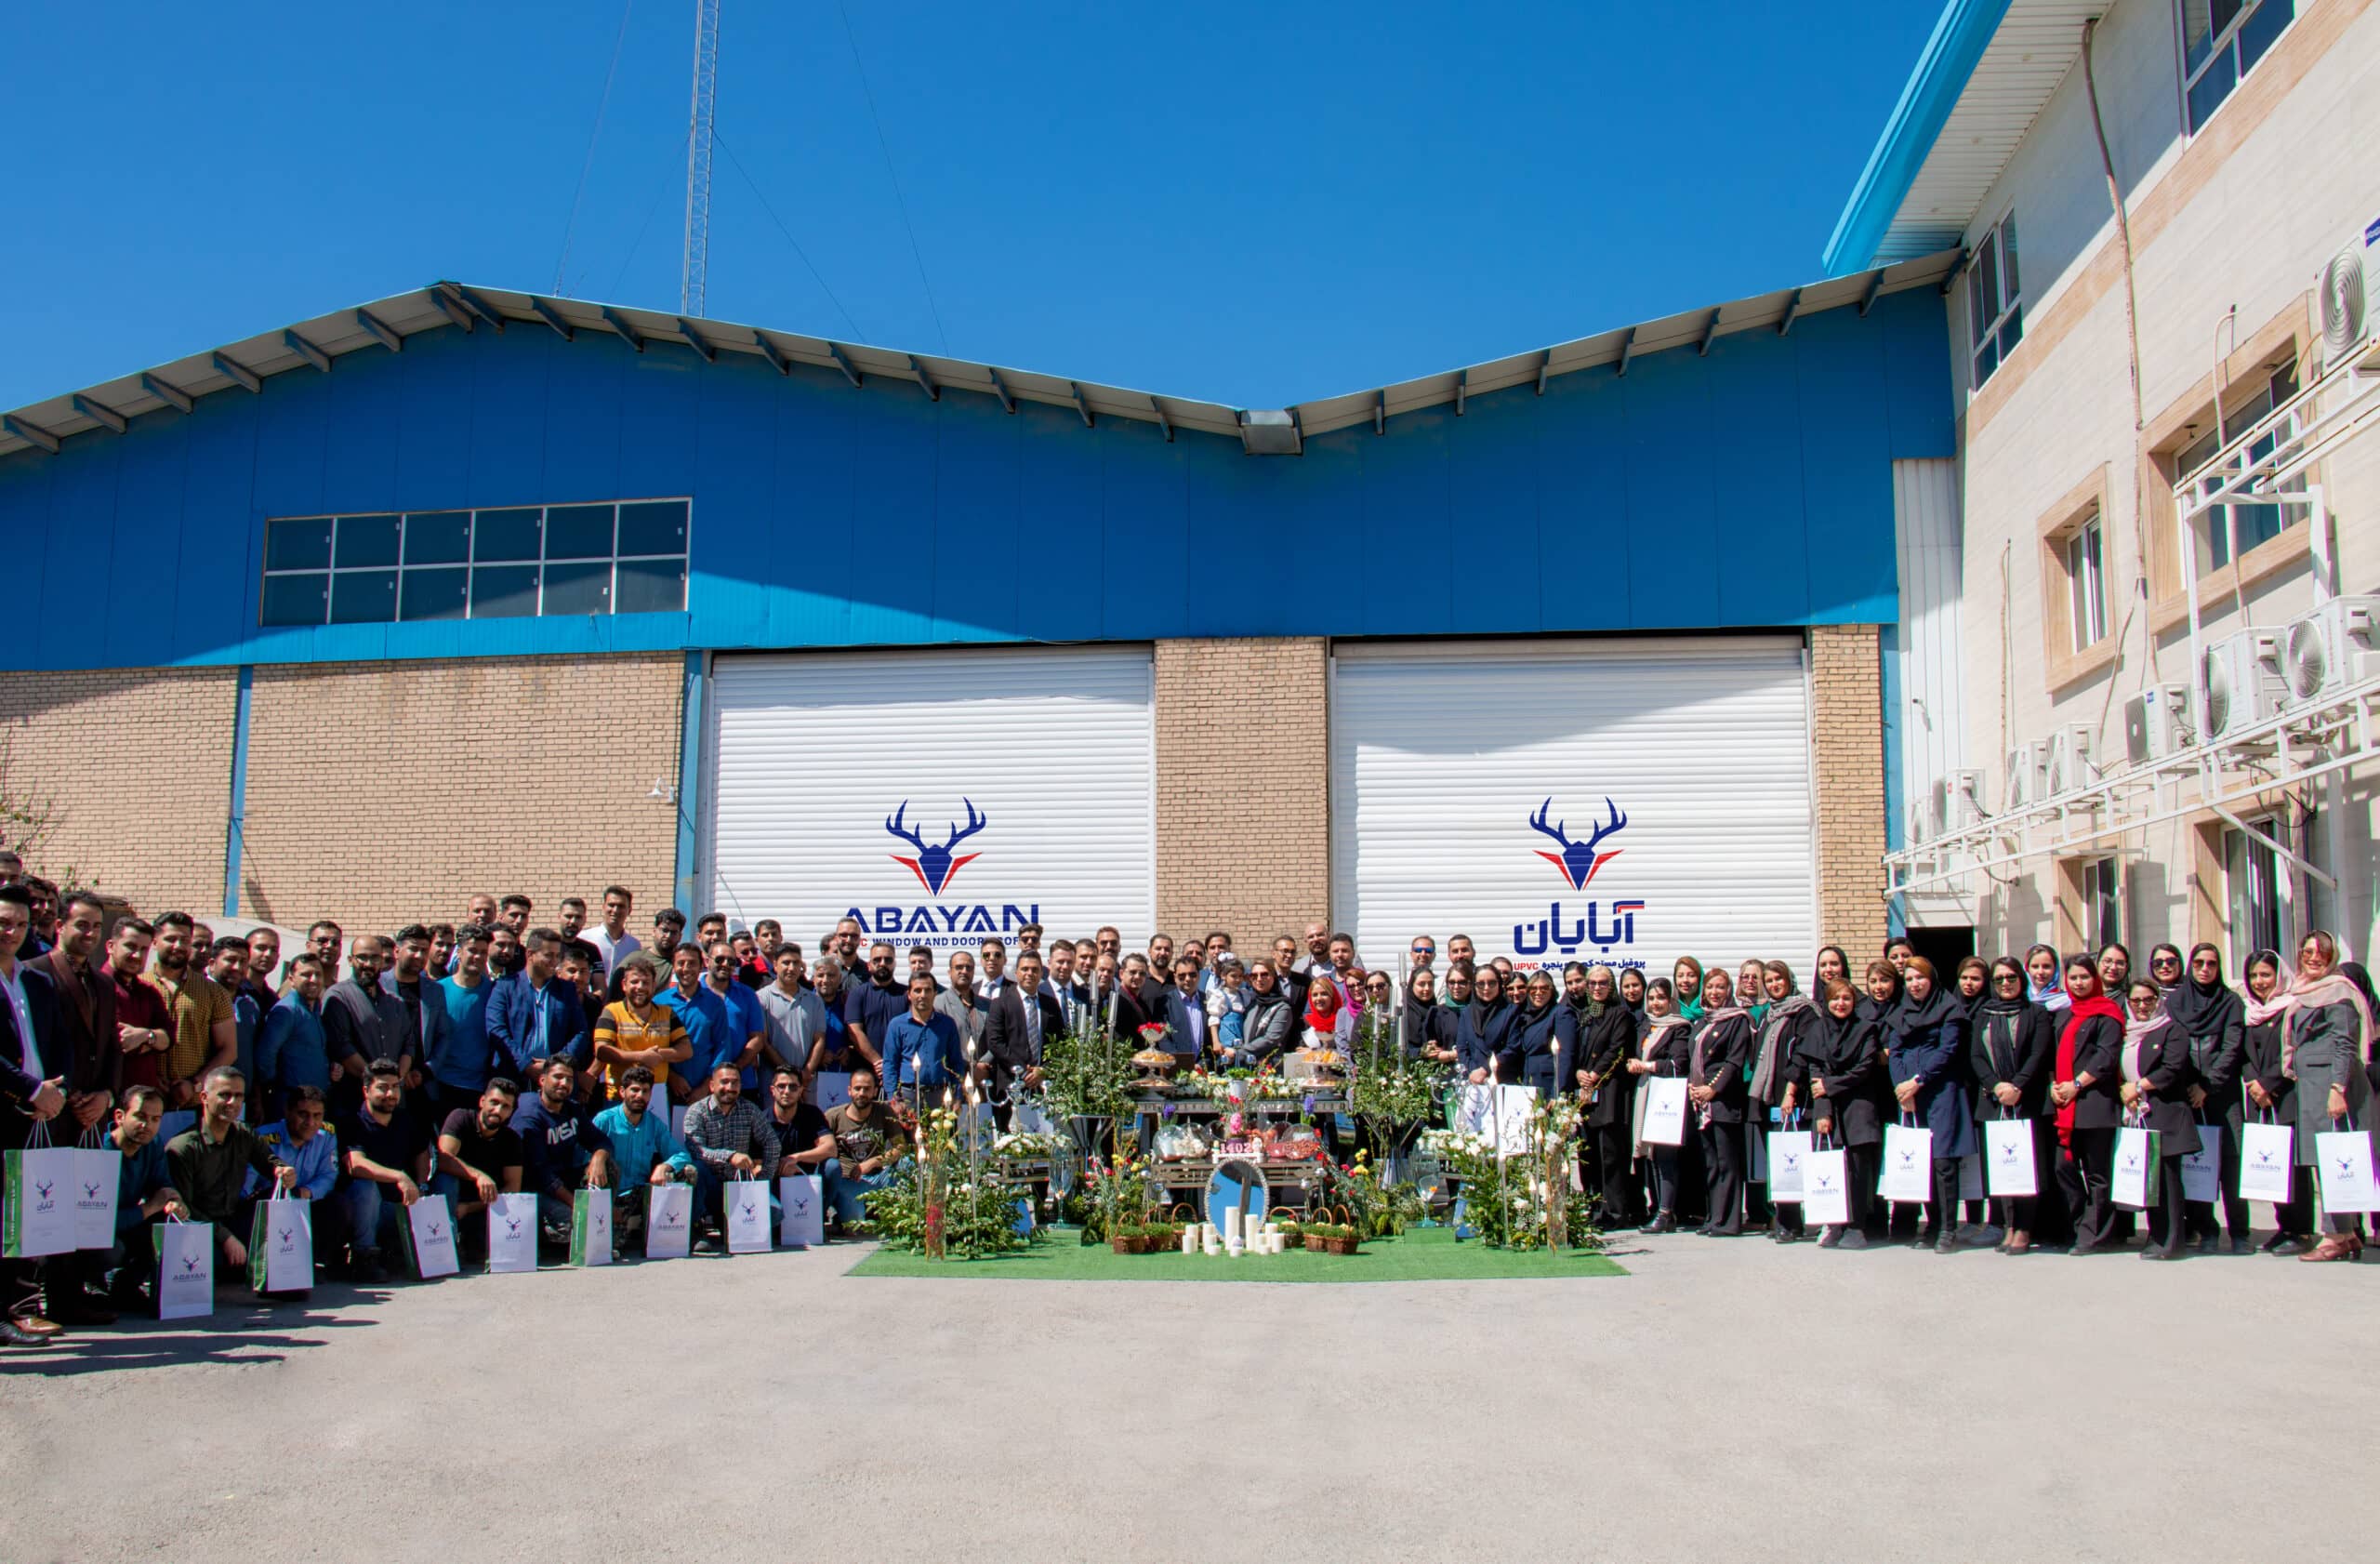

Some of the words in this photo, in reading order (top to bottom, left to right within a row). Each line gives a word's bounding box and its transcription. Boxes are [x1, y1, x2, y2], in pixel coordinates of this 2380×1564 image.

[845, 904, 1039, 934] ABAYAN
[1514, 900, 1645, 955] آبایان
[924, 937, 948, 946] AND
[1514, 962, 1539, 971] UPVC
[1541, 961, 1564, 972] پنجره
[1618, 959, 1646, 969] پروفیل
